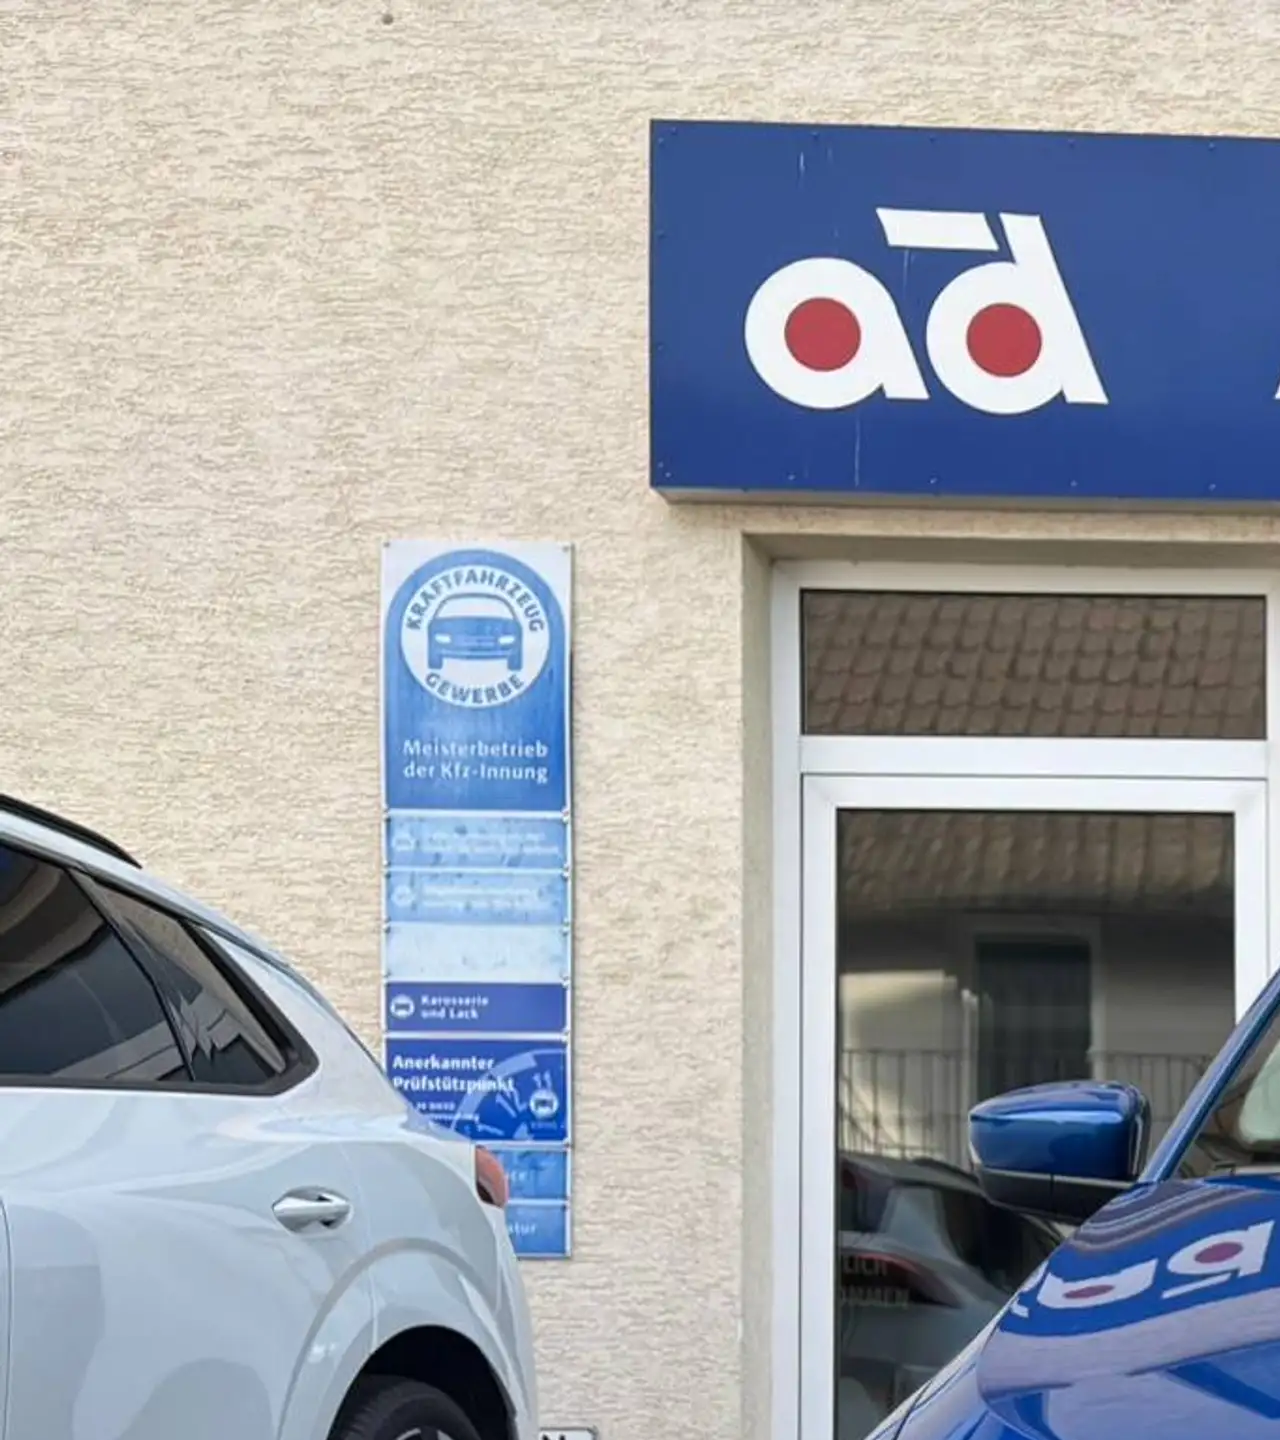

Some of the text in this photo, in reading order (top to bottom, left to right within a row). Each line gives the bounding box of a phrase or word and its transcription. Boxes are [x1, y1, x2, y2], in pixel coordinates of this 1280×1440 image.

[405, 569, 545, 632] KRAFTFAHRZEUG
[425, 672, 525, 704] GEWERBE
[403, 740, 549, 759] Meisterbetrieb
[403, 762, 549, 785] der Kfz-Innung
[421, 993, 490, 1007] Karosserie
[421, 1007, 480, 1020] und Lack
[392, 1054, 495, 1071] Anerkannter
[393, 1075, 515, 1095] Prüfstützpunkt
